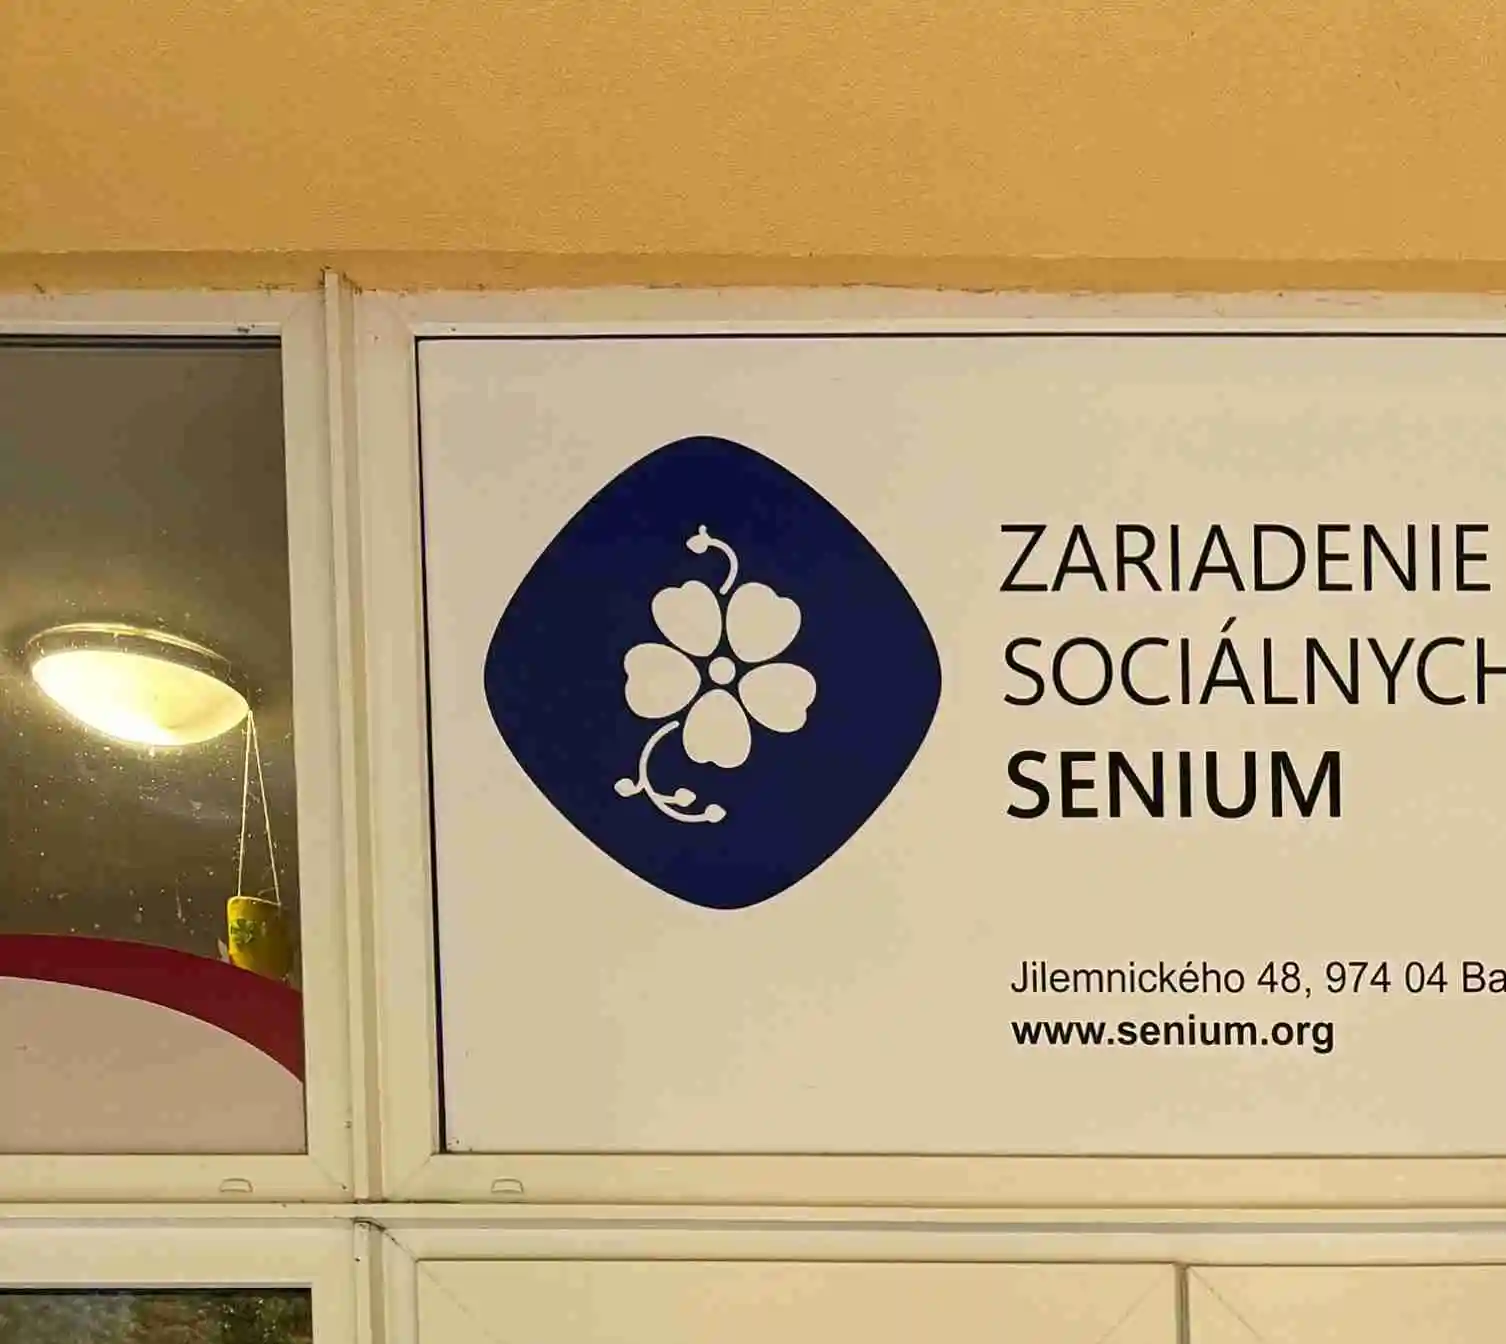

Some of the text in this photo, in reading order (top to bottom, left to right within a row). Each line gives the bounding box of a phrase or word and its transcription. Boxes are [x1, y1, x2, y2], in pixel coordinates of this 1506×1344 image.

[1000, 524, 1490, 591] ZARIADENIE
[1007, 751, 1340, 818] SENIUM
[1012, 961, 1244, 993] Jilemnického
[1258, 962, 1310, 998] 48,
[1327, 962, 1390, 993] 974
[1406, 962, 1447, 993] 04
[1012, 1014, 1333, 1053] www.senium.org
